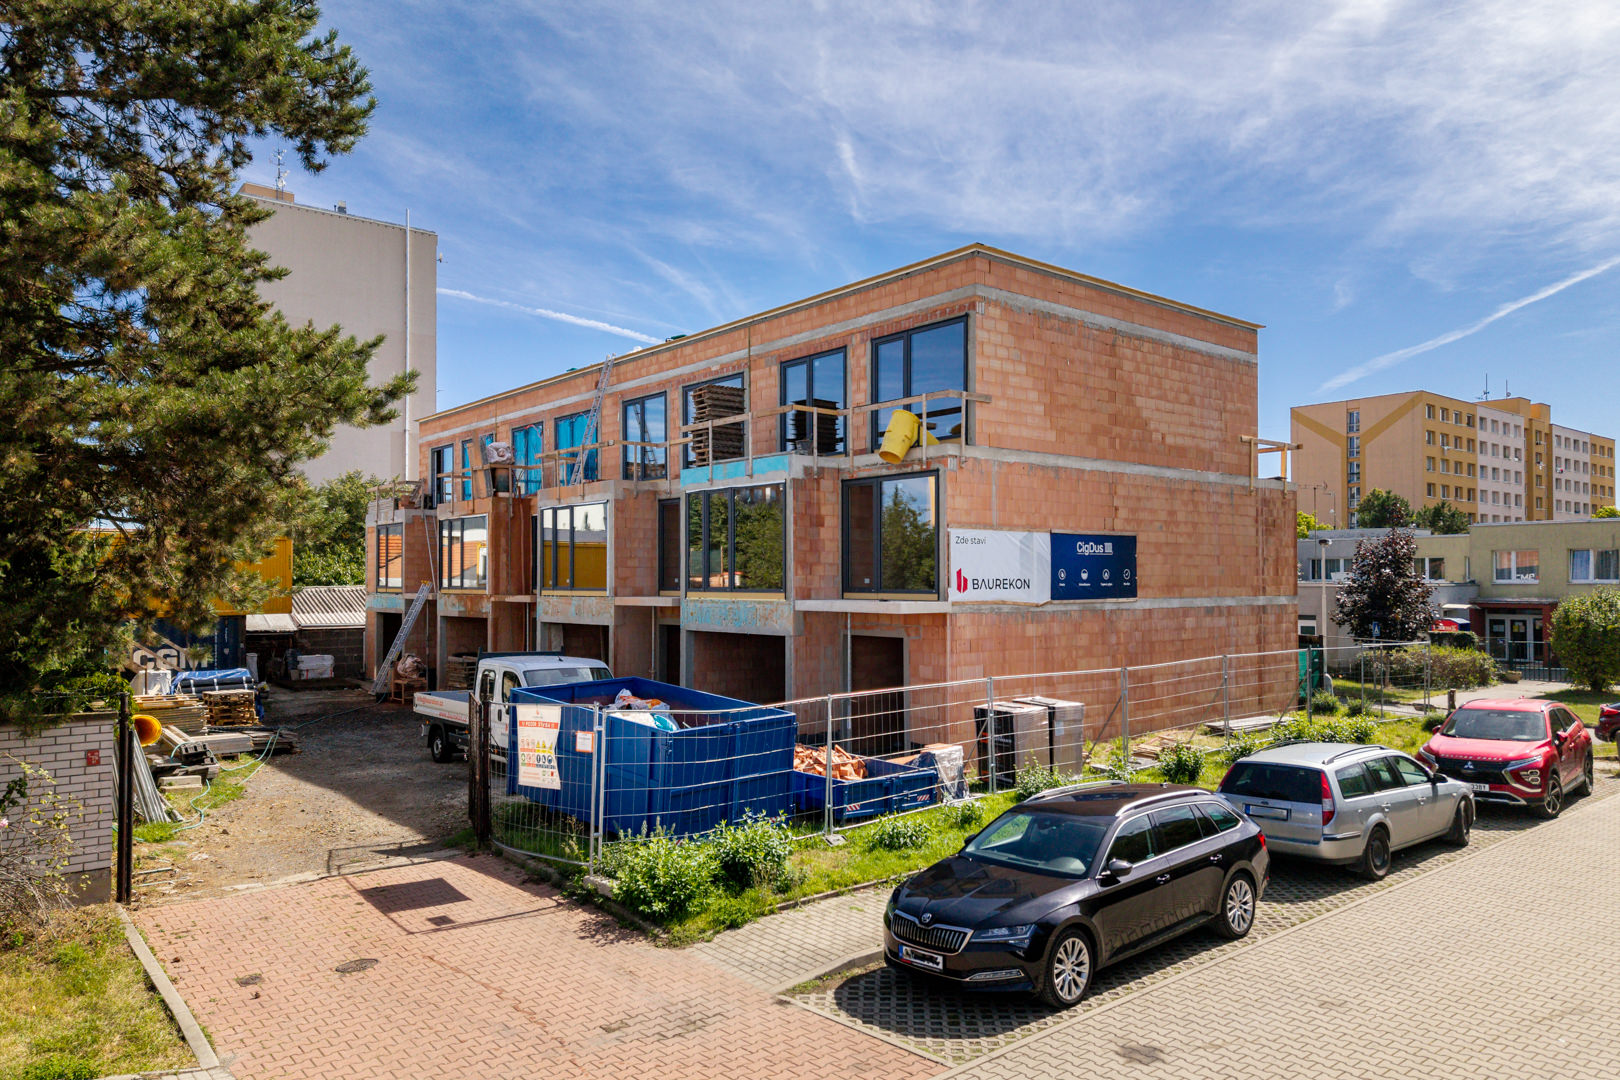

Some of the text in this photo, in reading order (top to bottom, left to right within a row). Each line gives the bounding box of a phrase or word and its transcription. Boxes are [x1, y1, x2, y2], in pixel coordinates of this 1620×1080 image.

[955, 536, 969, 545] Zde
[1076, 541, 1104, 556] CigDus
[972, 578, 1031, 590] BAUREKON
